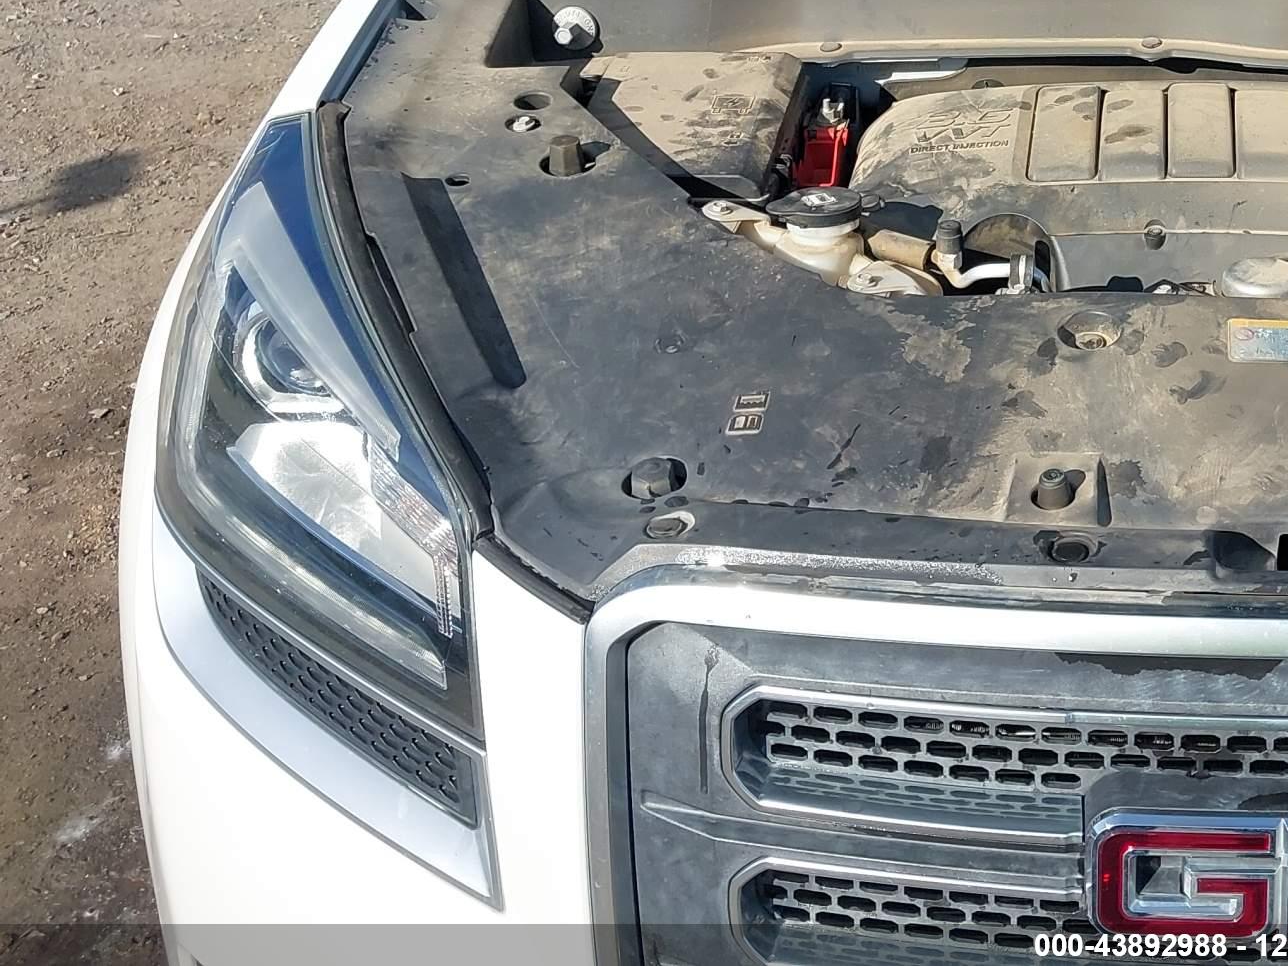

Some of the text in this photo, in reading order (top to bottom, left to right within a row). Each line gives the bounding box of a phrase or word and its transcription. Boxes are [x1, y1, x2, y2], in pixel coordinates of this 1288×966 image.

[916, 107, 1014, 130] 3.6
[910, 139, 1010, 154] DIRECT INJECTION
